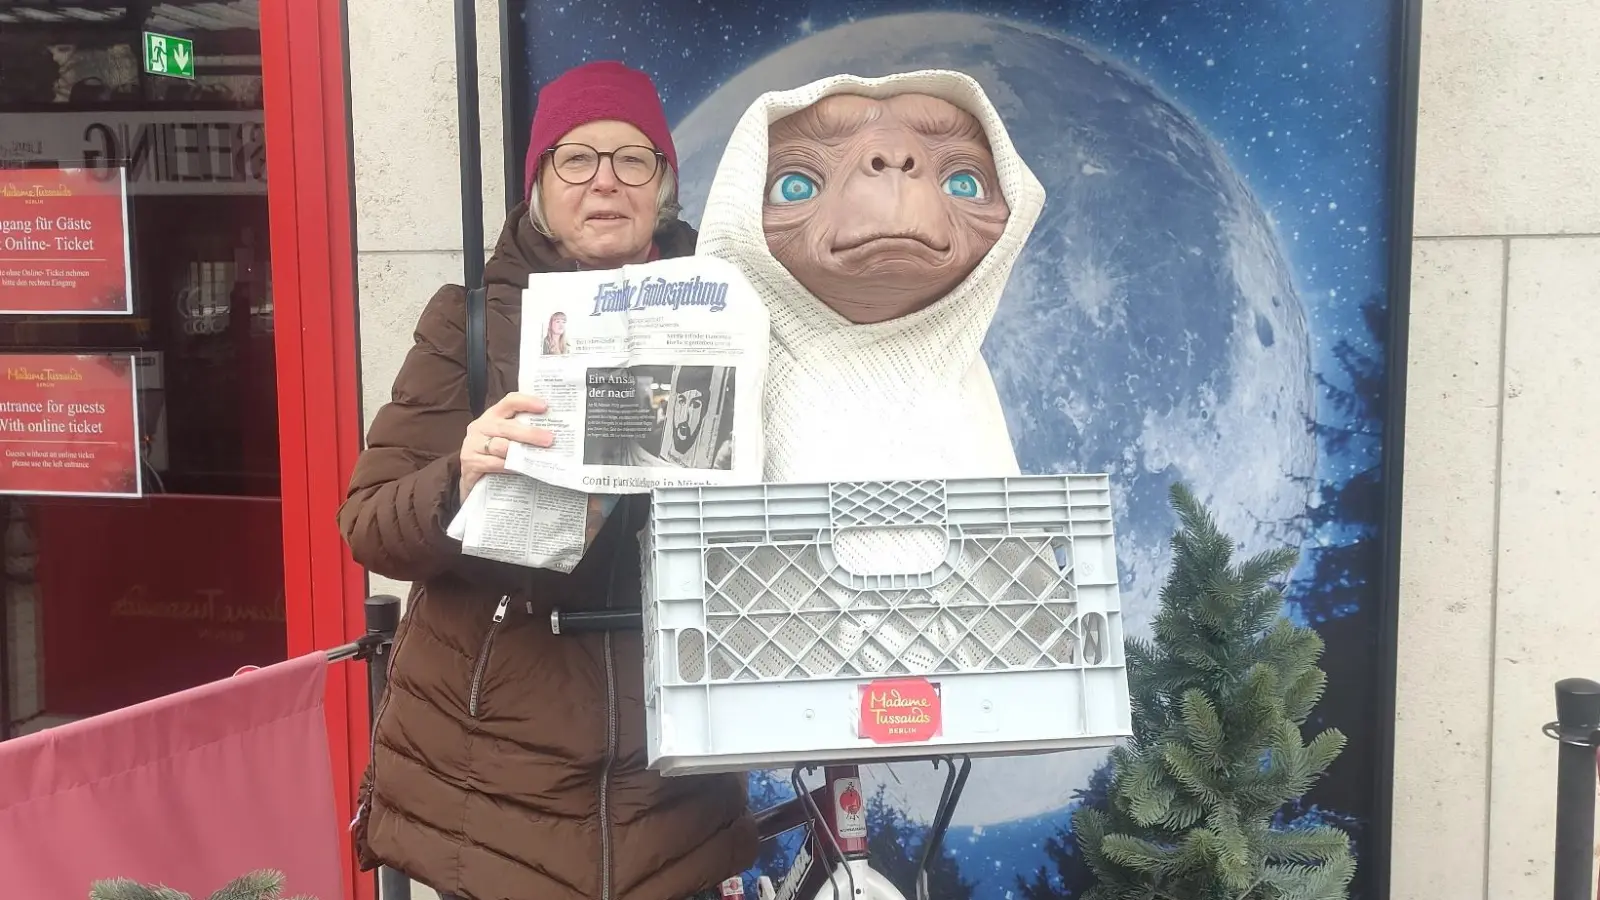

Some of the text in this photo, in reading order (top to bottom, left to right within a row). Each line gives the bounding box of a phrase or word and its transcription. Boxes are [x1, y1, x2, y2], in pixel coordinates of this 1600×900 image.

[35, 216, 53, 230] für
[56, 216, 92, 230] Gäste
[5, 236, 51, 251] Online-
[54, 236, 94, 251] Ticket
[6, 269, 21, 277] ohne
[46, 269, 64, 277] Ticket
[65, 269, 90, 277] nehmen
[16, 278, 28, 286] den
[28, 278, 51, 287] rechten
[51, 279, 76, 288] Eingang
[8, 367, 83, 381] Madame Tussauds
[589, 373, 606, 384] Ein
[589, 387, 605, 398] der
[0, 400, 105, 416] ntrance for guests
[28, 419, 65, 433] online
[68, 420, 103, 434] ticket
[5, 449, 26, 457] Guests
[27, 449, 49, 458] without
[58, 450, 77, 459] online
[78, 451, 95, 459] ticket
[12, 460, 30, 468] please
[42, 460, 52, 468] the
[52, 460, 63, 468] left
[582, 476, 610, 487] Conti
[870, 688, 931, 709] Madame
[869, 706, 931, 725] Tussauds
[888, 727, 917, 735] BERLIN
